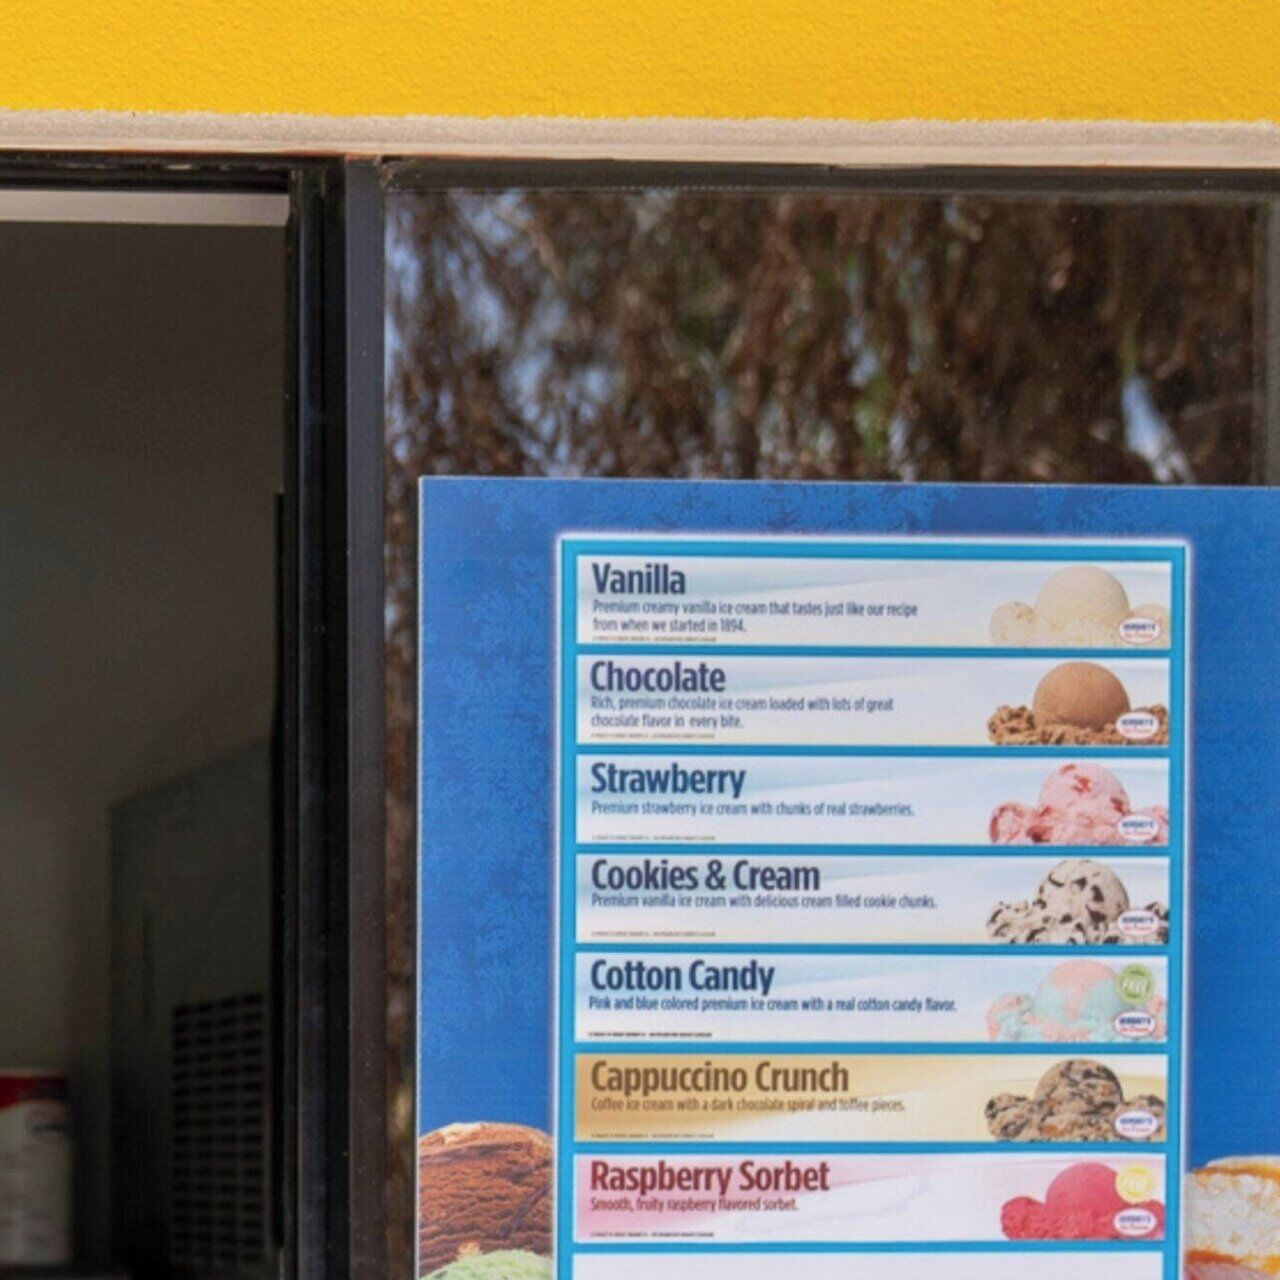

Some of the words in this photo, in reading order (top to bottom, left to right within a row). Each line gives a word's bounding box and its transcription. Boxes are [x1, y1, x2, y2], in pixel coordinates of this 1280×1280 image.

[591, 562, 686, 595] Vanilla
[592, 600, 640, 613] Premium
[642, 603, 680, 617] creamy
[682, 601, 716, 614] vanilla
[718, 601, 734, 614] ice
[734, 604, 768, 614] cream
[768, 601, 790, 614] that
[792, 602, 822, 615] tastes
[824, 602, 844, 618] just
[846, 602, 864, 615] like
[866, 604, 884, 615] our
[886, 602, 918, 618] recipe
[594, 619, 618, 632] from
[620, 619, 648, 632] when
[652, 622, 666, 632] we
[670, 620, 706, 632] started
[706, 620, 718, 632] in
[720, 620, 746, 632] 1894.
[589, 661, 726, 693] Chocolate
[590, 697, 616, 712] Rich,
[618, 697, 666, 712] premium
[668, 697, 716, 709] chocolate
[718, 697, 734, 710] ice
[736, 700, 768, 710] cream
[768, 697, 806, 710] loaded
[808, 698, 830, 710] with
[832, 698, 852, 710] lots
[854, 698, 866, 710] of
[866, 698, 894, 713] great
[592, 715, 640, 728] chocolate
[642, 715, 672, 728] flavor
[674, 715, 684, 728] in
[690, 718, 718, 731] every
[720, 715, 744, 728] bite.
[590, 761, 747, 799] Strawberry
[590, 802, 640, 814] Premium
[642, 802, 698, 818] strawberry
[700, 802, 714, 815] ice
[716, 805, 748, 815] cream
[750, 803, 772, 815] with
[776, 803, 812, 815] chunks
[814, 803, 824, 815] of
[826, 803, 846, 816] real
[848, 803, 916, 816] strawberries.
[591, 859, 699, 892] Cookies
[704, 859, 727, 891] &
[732, 859, 821, 892] Cream
[590, 895, 640, 907] Premium
[642, 895, 676, 907] vanilla
[678, 895, 692, 907] ice
[694, 897, 726, 907] cream
[728, 895, 752, 907] with
[754, 895, 800, 907] delicious
[802, 898, 832, 908] cream
[834, 896, 862, 908] filled
[864, 896, 896, 908] cookie
[898, 896, 938, 908] chunks.
[590, 959, 682, 991] Cotton
[688, 959, 775, 996] Candy
[588, 997, 612, 1009] Pink
[614, 997, 634, 1009] and
[634, 997, 658, 1010] blue
[660, 997, 700, 1010] colored
[700, 997, 748, 1013] premium
[750, 997, 766, 1010] ice
[766, 1000, 798, 1010] cream
[802, 998, 824, 1011] with
[826, 1000, 834, 1011] a
[836, 998, 856, 1011] real
[858, 998, 890, 1011] cotton
[892, 998, 922, 1014] candy
[924, 998, 958, 1011] flavor.
[590, 1060, 748, 1097] Cappuccino
[754, 1060, 849, 1093] Crunch
[590, 1097, 624, 1110] Coffee
[626, 1098, 640, 1110] ice
[642, 1100, 674, 1110] cream
[676, 1098, 698, 1111] with
[702, 1100, 708, 1111] a
[710, 1098, 734, 1111] dark
[736, 1098, 784, 1111] chocolate
[786, 1098, 816, 1114] spiral
[818, 1099, 838, 1111] and
[840, 1099, 870, 1112] toffee
[872, 1099, 906, 1115] pieces.
[590, 1160, 733, 1196] Raspberry
[738, 1160, 831, 1192] Sorbet
[590, 1197, 634, 1214] Smooth,
[636, 1197, 664, 1214] fruity
[666, 1197, 716, 1214] raspberry
[718, 1198, 760, 1211] flavored
[762, 1198, 798, 1211] sorbet.
